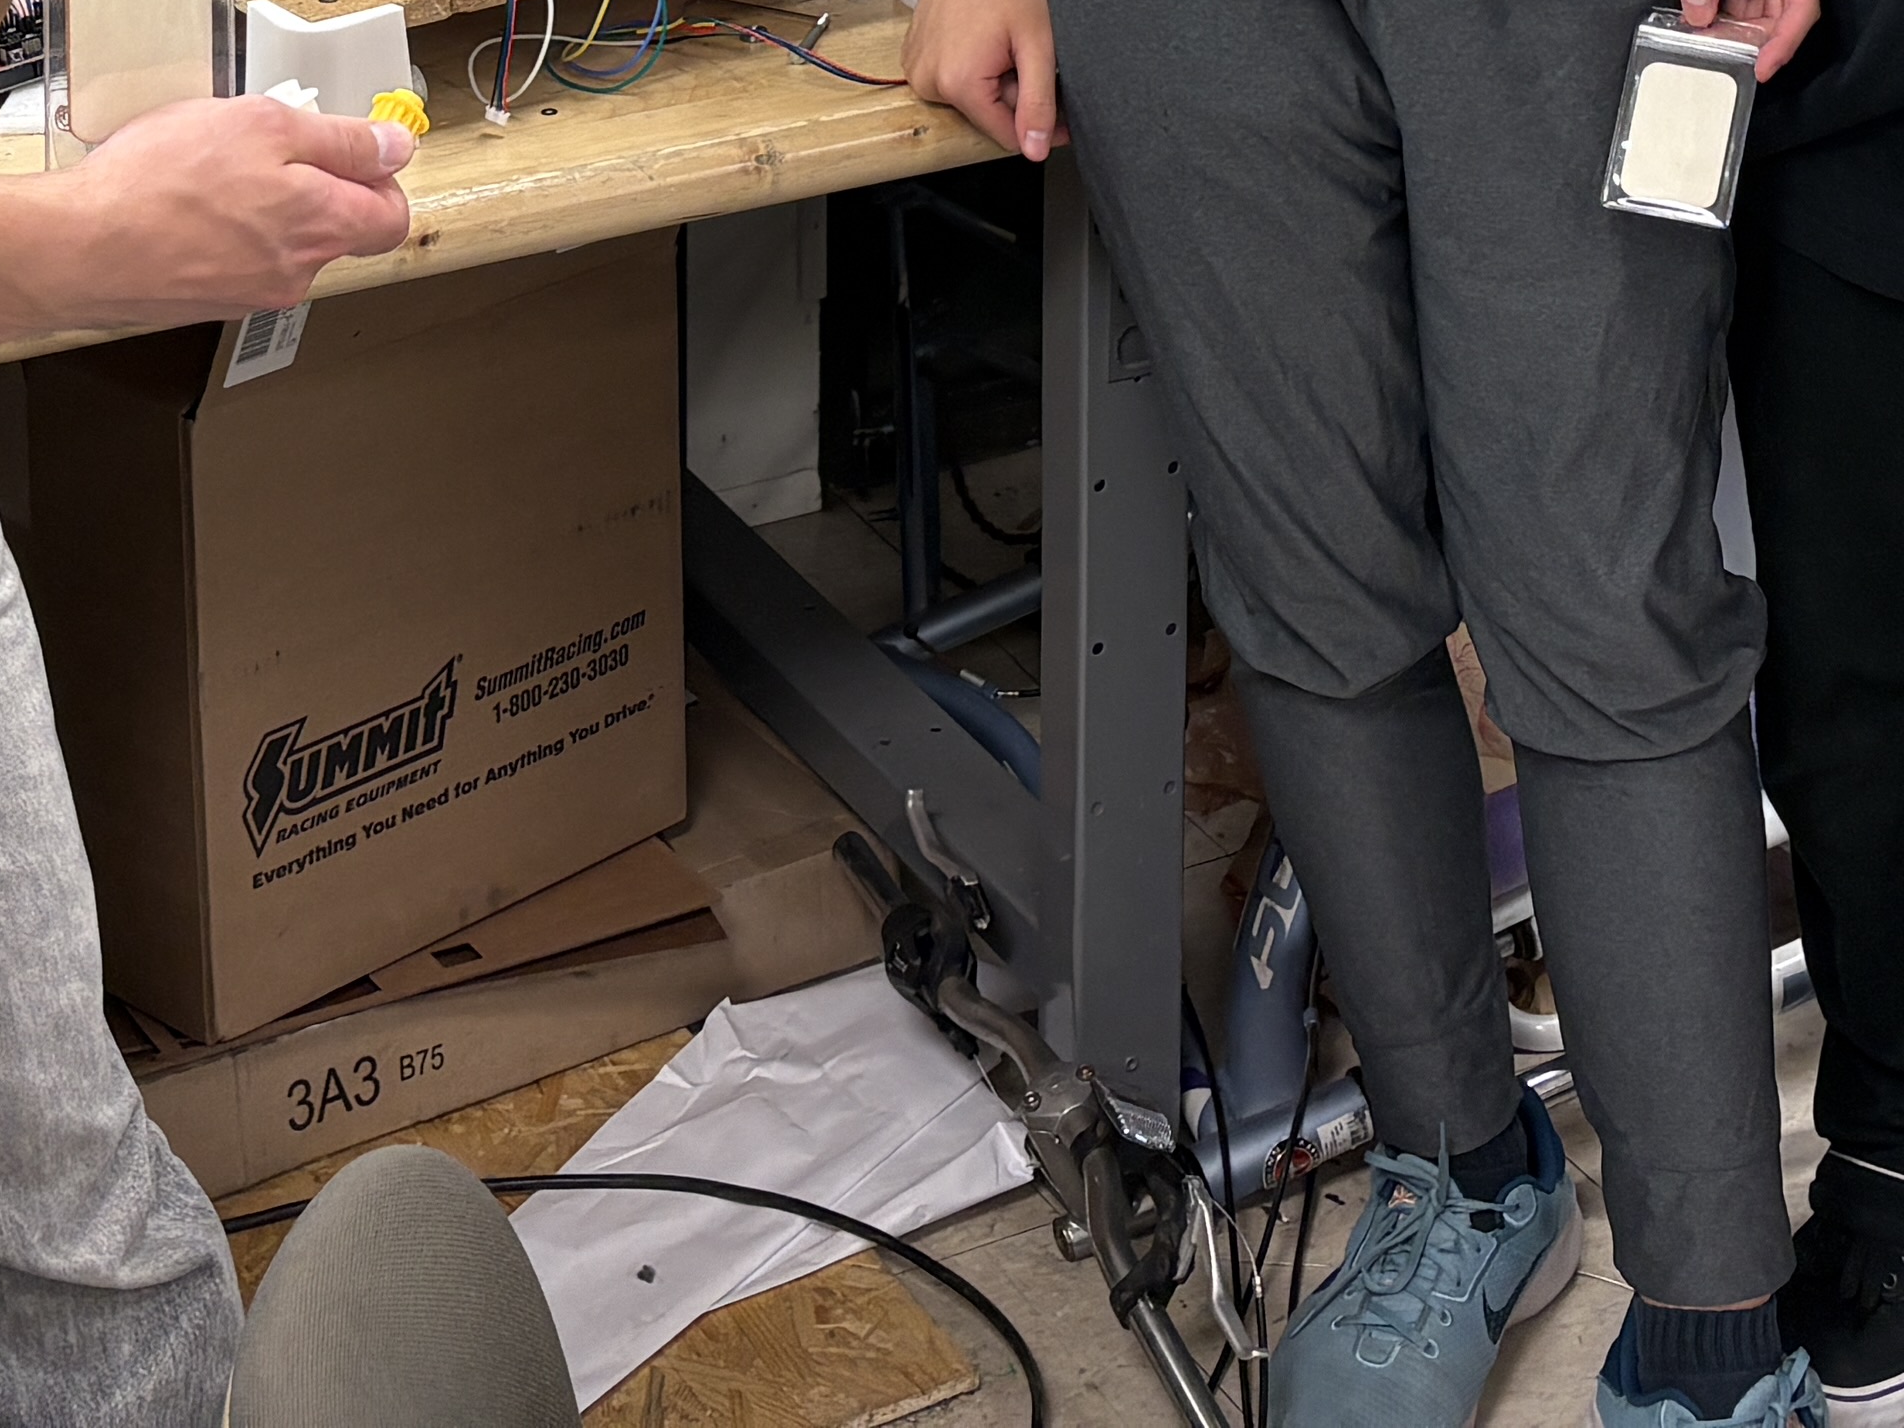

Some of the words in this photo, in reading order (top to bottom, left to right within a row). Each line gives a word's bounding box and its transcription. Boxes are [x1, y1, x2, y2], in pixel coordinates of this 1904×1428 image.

[474, 609, 647, 702] SummitRacing.com
[492, 643, 630, 724] 1-800-230-3030
[252, 831, 357, 890] Everything
[362, 807, 398, 839] You
[401, 787, 449, 824] Need
[454, 776, 481, 799] for
[484, 738, 566, 786] Anything
[568, 720, 600, 745] You
[275, 804, 340, 844] RACING
[345, 758, 442, 814] EQUIPMENT
[287, 1055, 381, 1132] 3A3
[399, 1043, 445, 1082] B75
